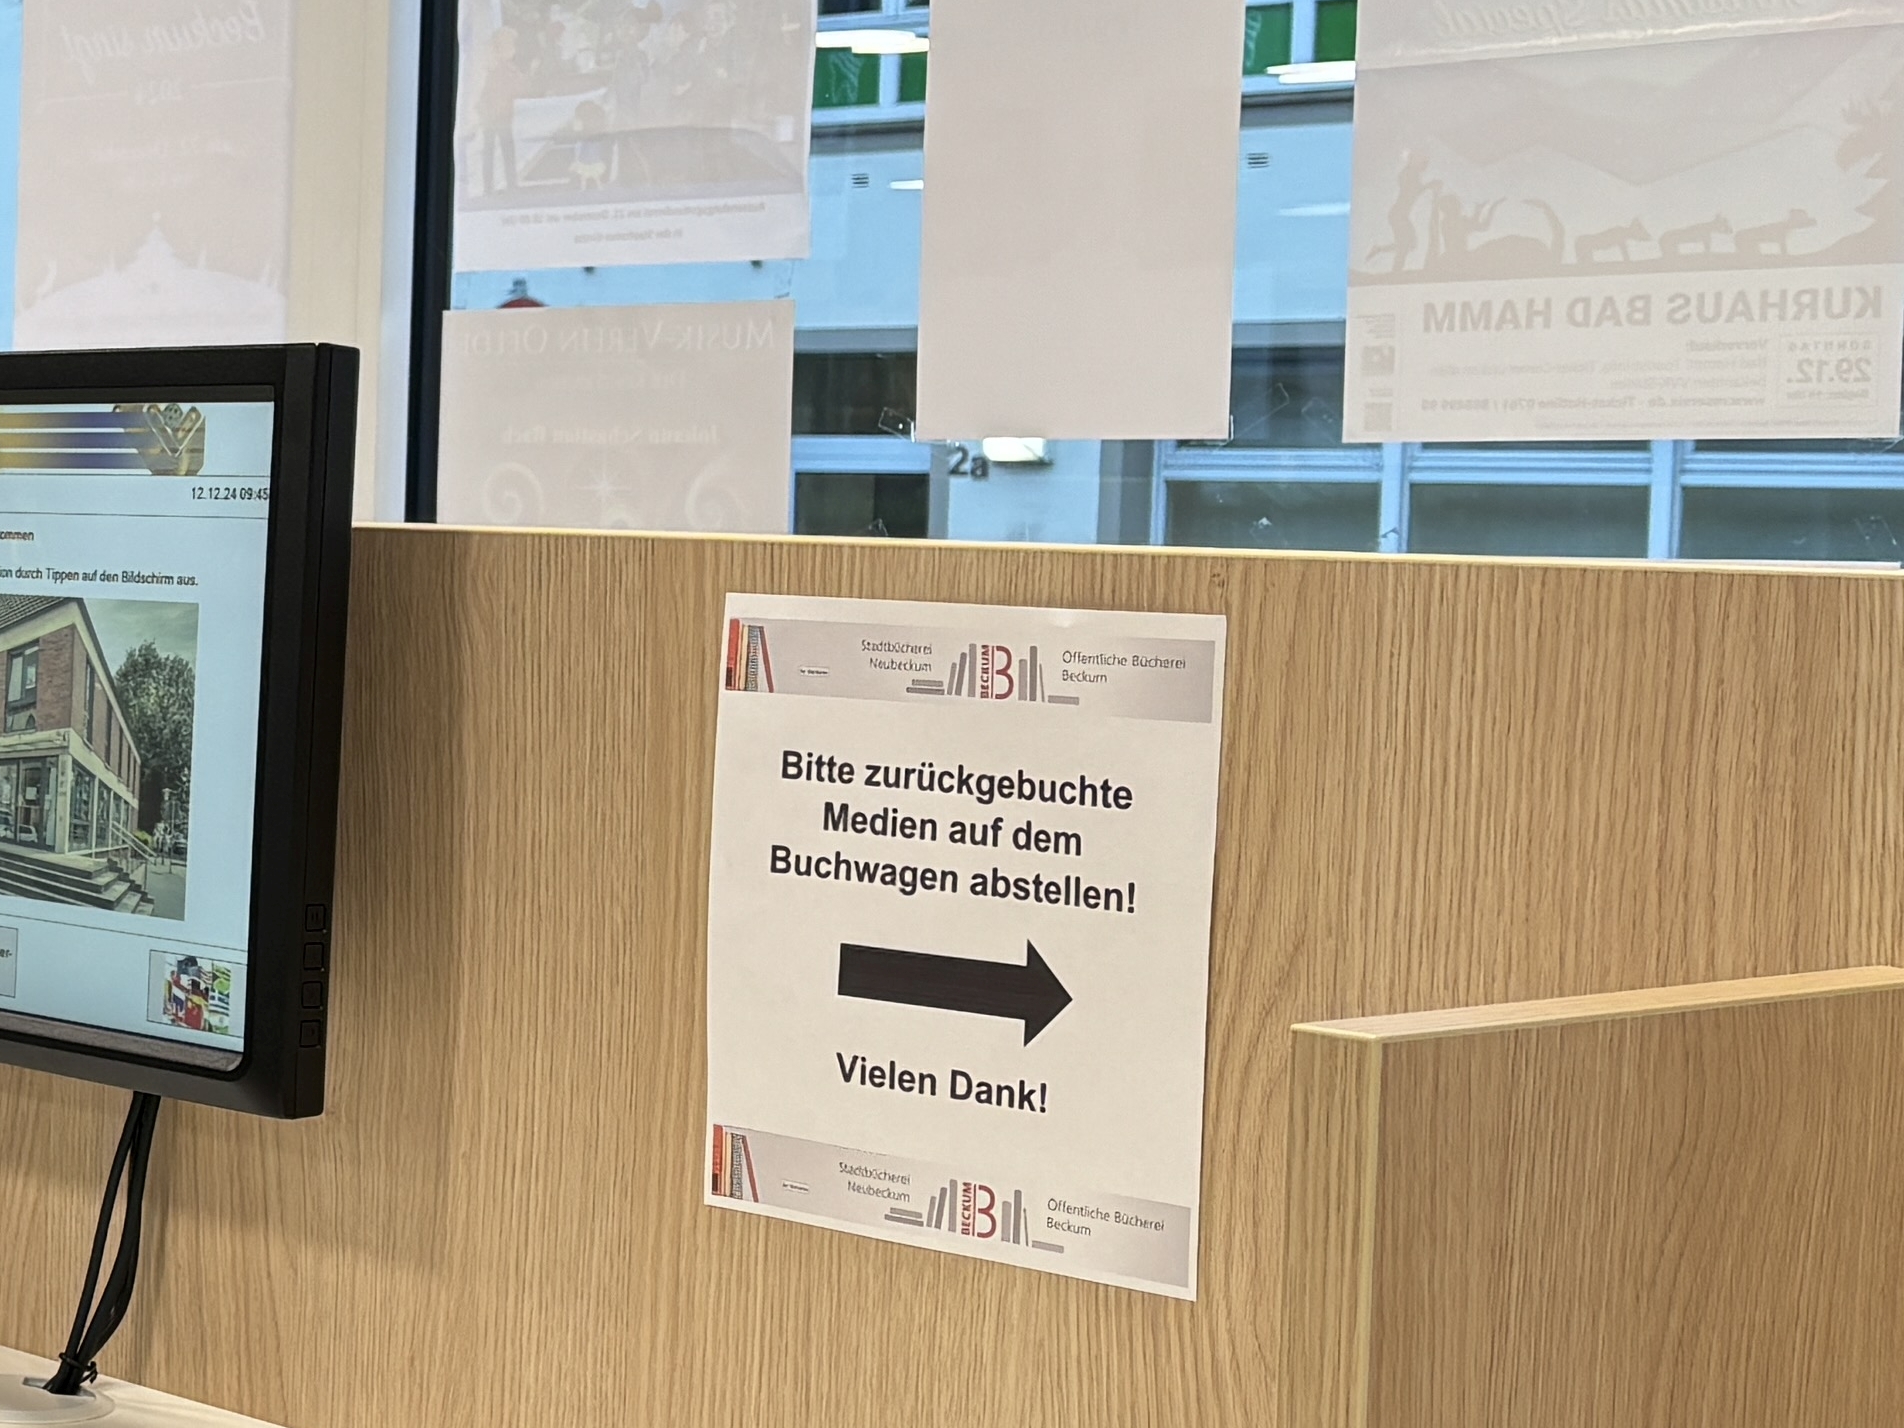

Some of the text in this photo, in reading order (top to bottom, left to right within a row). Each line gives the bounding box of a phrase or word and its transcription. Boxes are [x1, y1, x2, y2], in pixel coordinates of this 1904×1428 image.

[948, 443, 990, 480] 2a
[192, 486, 270, 501] 12.12.24 09:45
[15, 566, 43, 580] durch
[45, 567, 80, 585] Tippen
[82, 569, 97, 582] auf
[99, 570, 119, 584] den
[121, 570, 175, 586] Bildschirm
[177, 575, 199, 587] aus.
[860, 638, 933, 656] Stadtbücherei
[869, 656, 933, 674] Neubeckum
[980, 644, 990, 700] BECKUM
[1131, 654, 1187, 671] Bücherei
[1061, 668, 1108, 684] Beckum
[781, 748, 1135, 812] Bitte zurückgebuchte
[822, 801, 1084, 858] Medien auf dem
[769, 844, 1137, 916] Buchwagen abstellen!
[835, 1052, 1050, 1115] Vielen Dank!
[838, 1160, 912, 1187] Stadtbücherei
[846, 1180, 911, 1204] Neubeckum
[961, 1181, 973, 1237] BECKUM
[1046, 1216, 1092, 1237] Beckum
[1113, 1210, 1166, 1233] Bücherei
